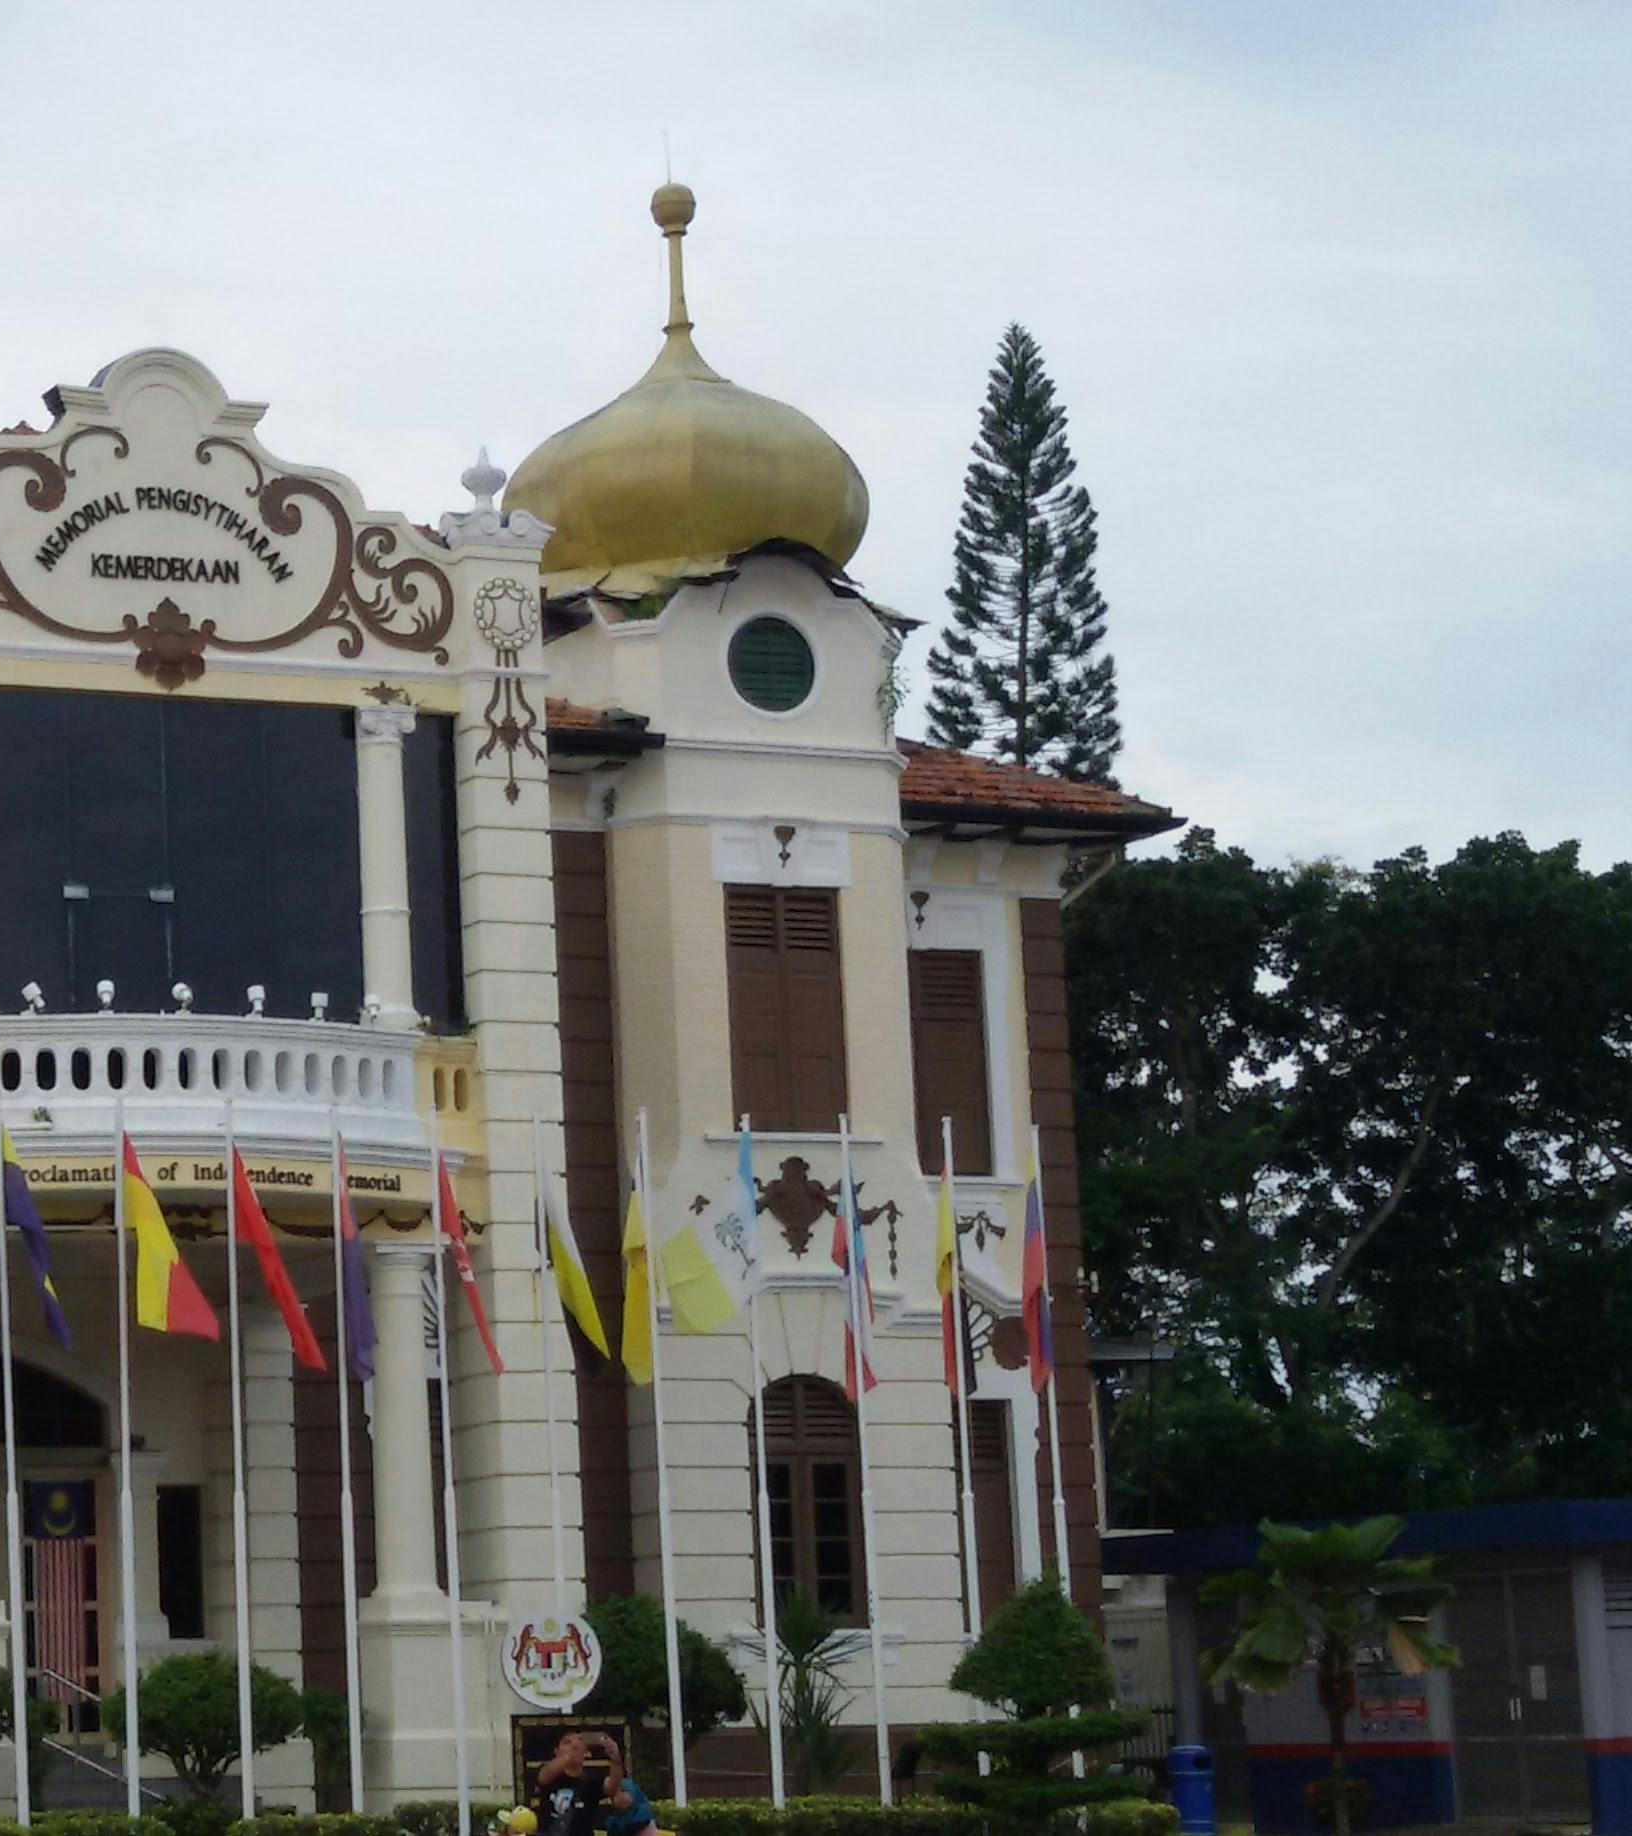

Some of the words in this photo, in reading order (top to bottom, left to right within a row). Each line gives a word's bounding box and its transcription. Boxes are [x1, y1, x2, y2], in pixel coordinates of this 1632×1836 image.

[35, 492, 130, 572] MEMORIAL
[135, 486, 294, 584] PENGISYTIHARAN
[91, 552, 240, 585] KEMERDEKAAN
[156, 1161, 178, 1181] of
[346, 1172, 402, 1192] emorial
